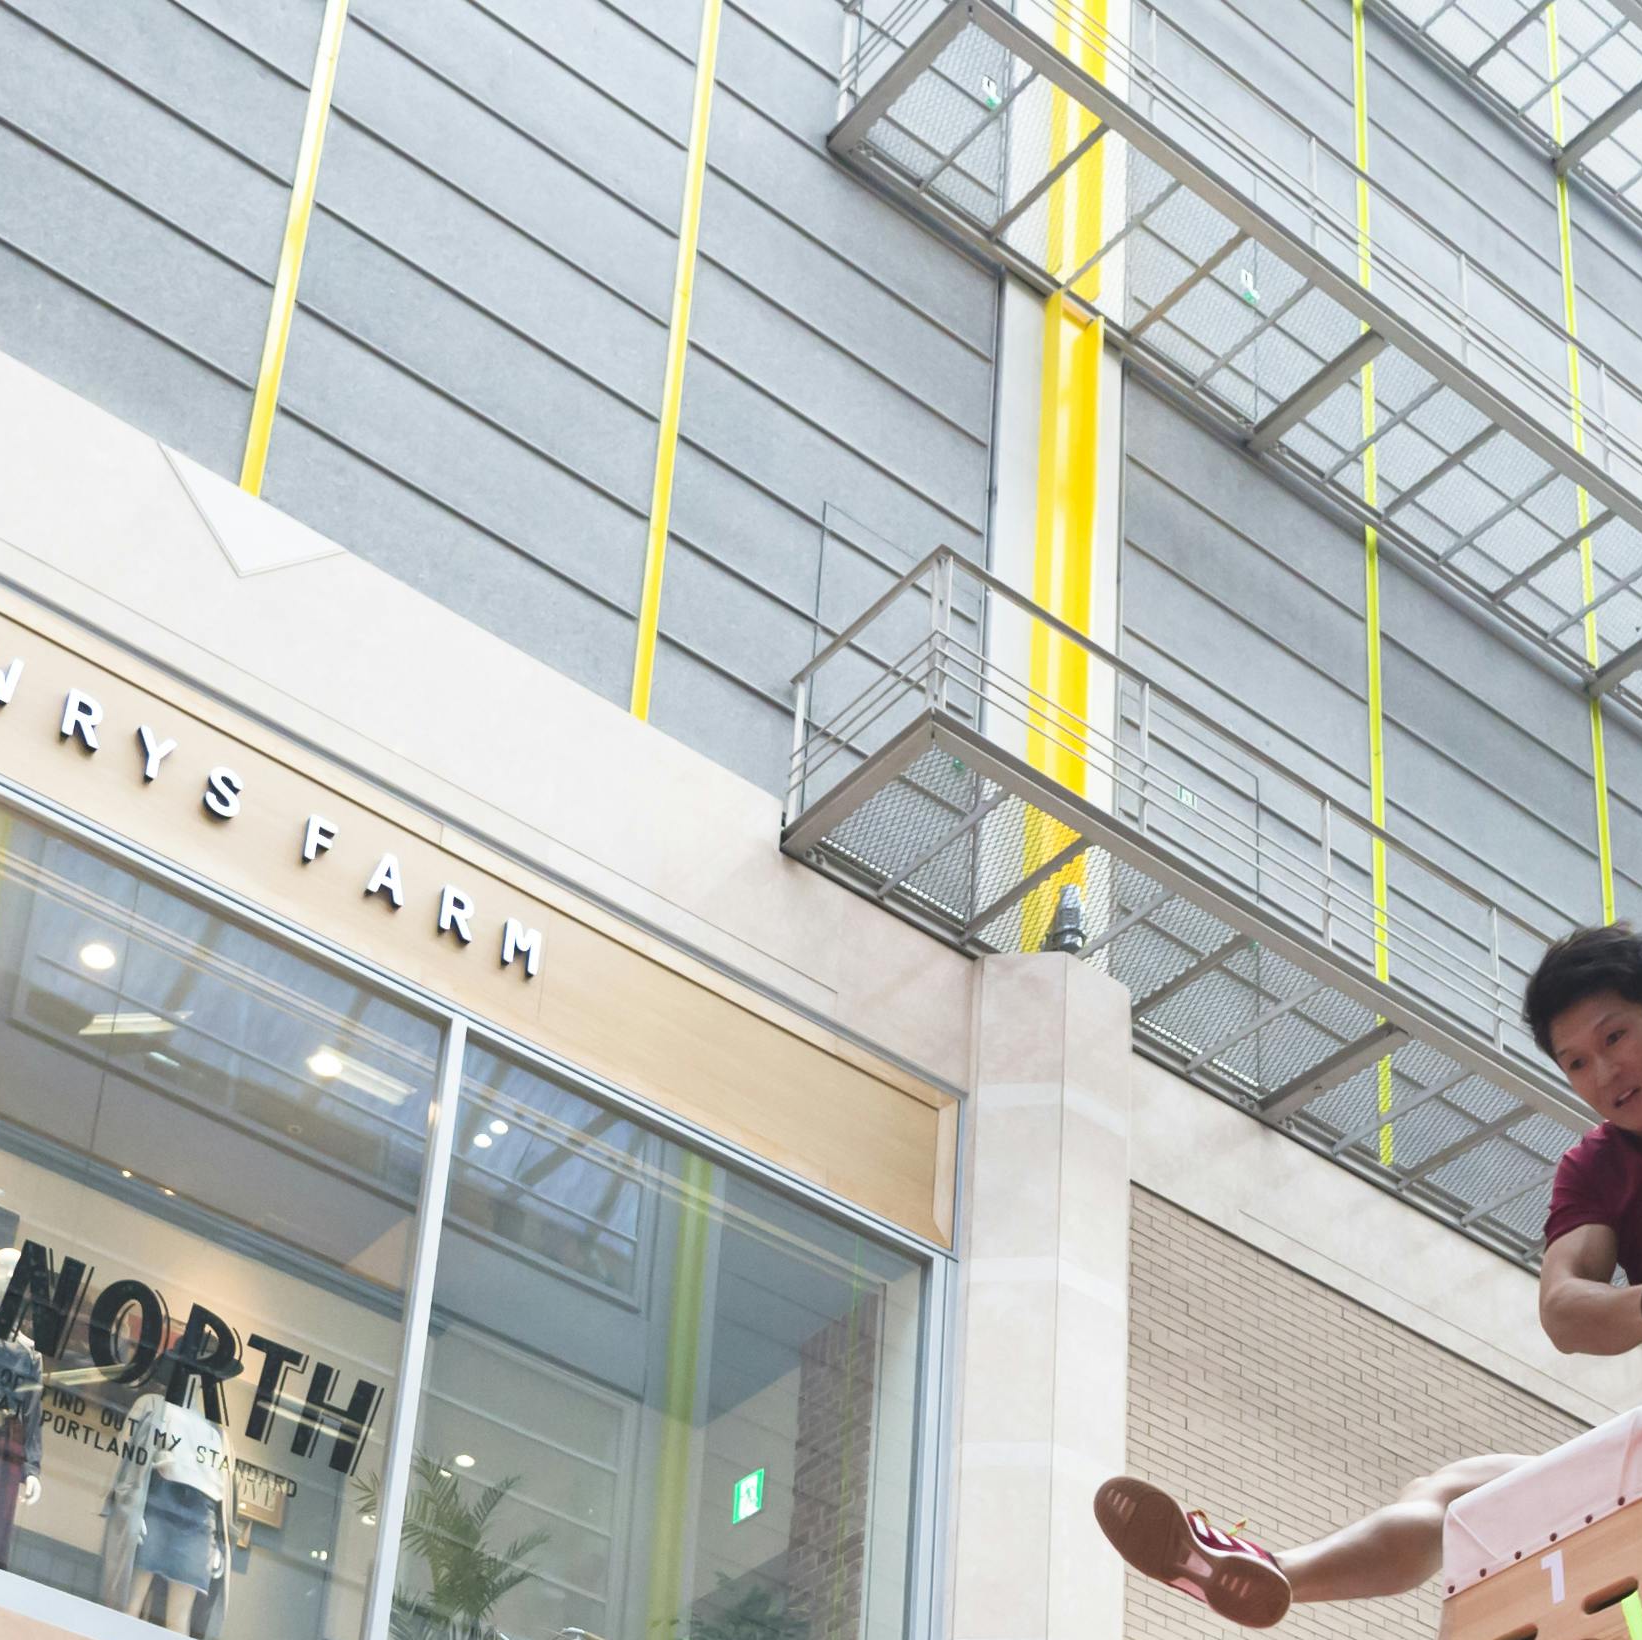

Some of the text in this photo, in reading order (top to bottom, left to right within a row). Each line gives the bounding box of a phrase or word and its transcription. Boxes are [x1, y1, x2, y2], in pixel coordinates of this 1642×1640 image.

[302, 814, 542, 977] FARM
[40, 1409, 150, 1467] PORTLAND
[41, 1384, 85, 1416] FIND
[101, 1404, 140, 1437] OUT
[153, 1427, 182, 1453] MY
[196, 1446, 298, 1498] STANDARD
[1540, 1551, 1565, 1604] 1
